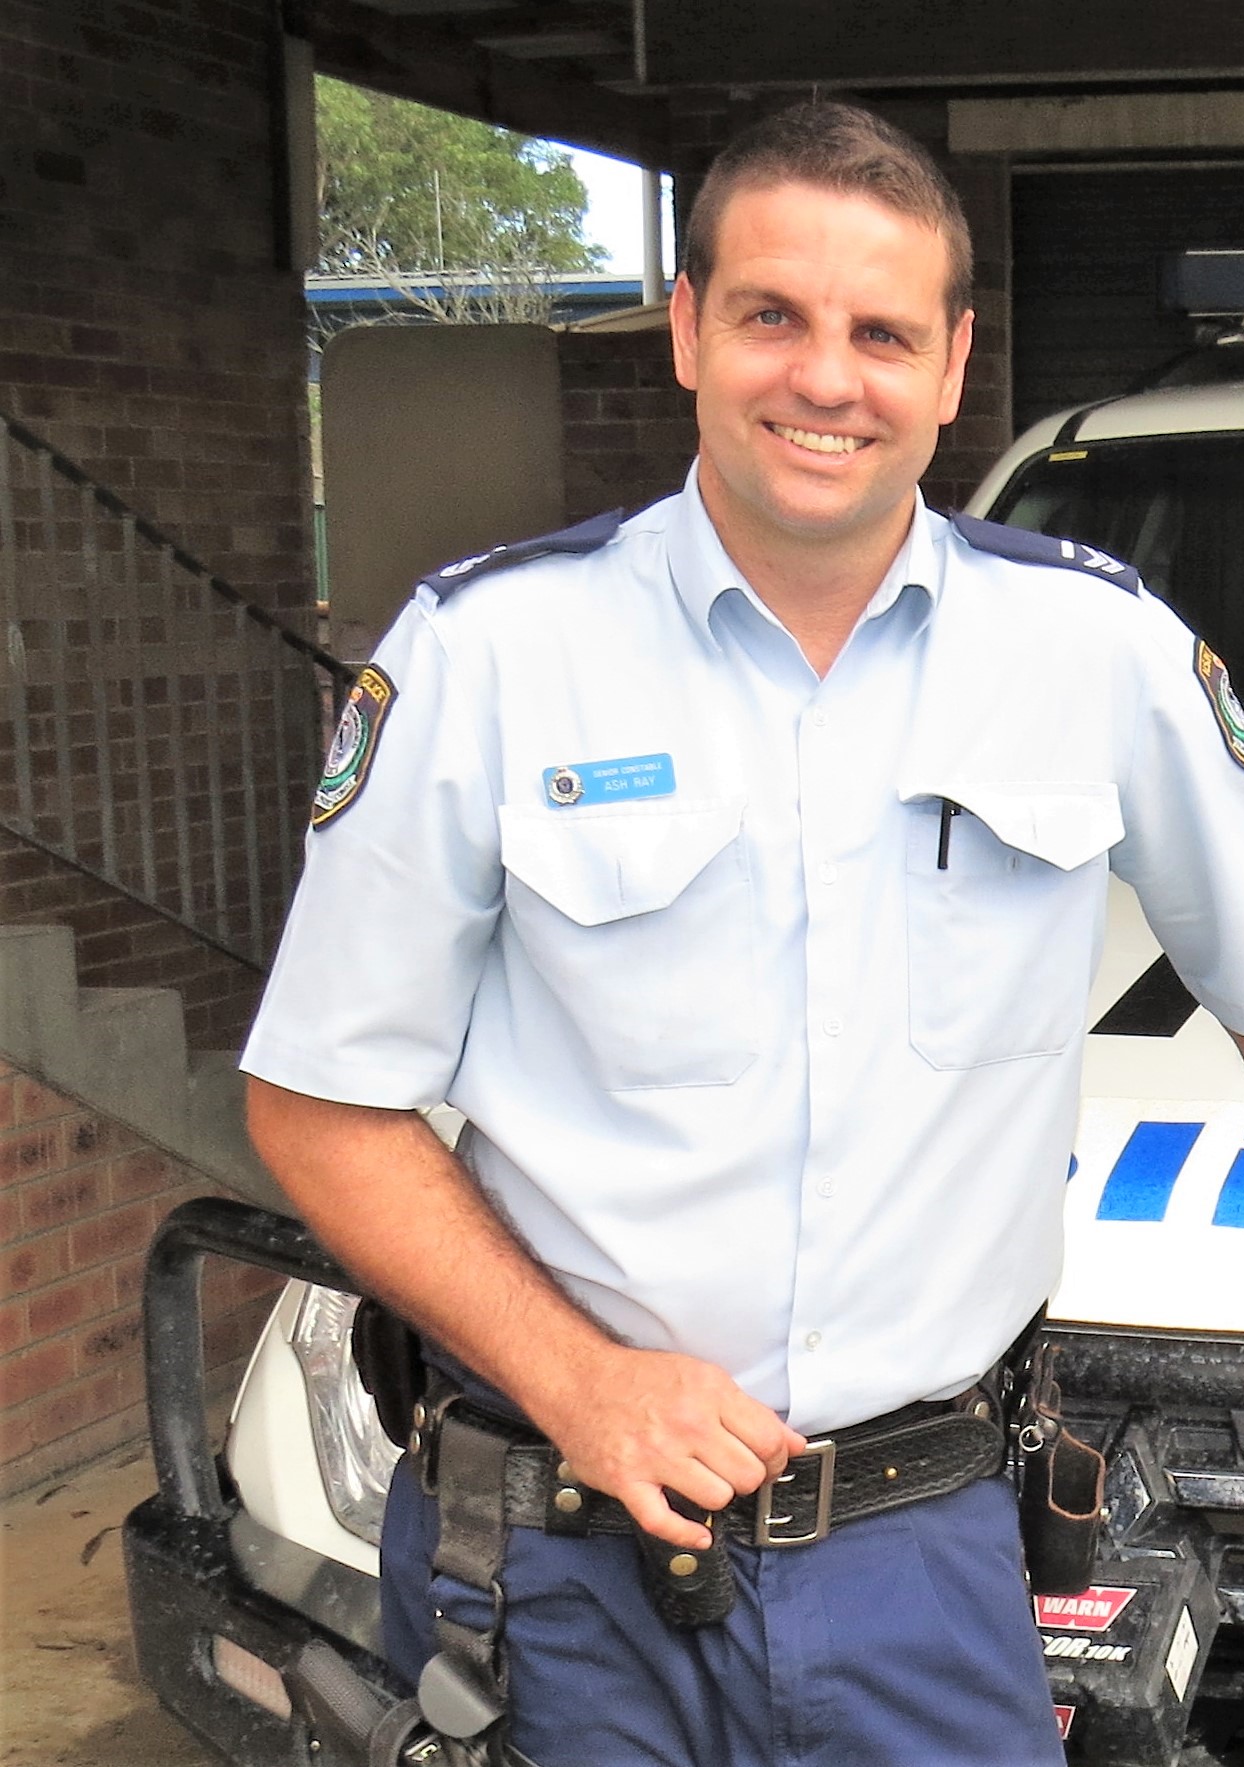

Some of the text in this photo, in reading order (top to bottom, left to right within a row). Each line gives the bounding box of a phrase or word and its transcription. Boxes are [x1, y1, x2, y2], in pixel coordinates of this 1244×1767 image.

[604, 775, 657, 792] ASH RAY
[1043, 1597, 1113, 1617] WARN
